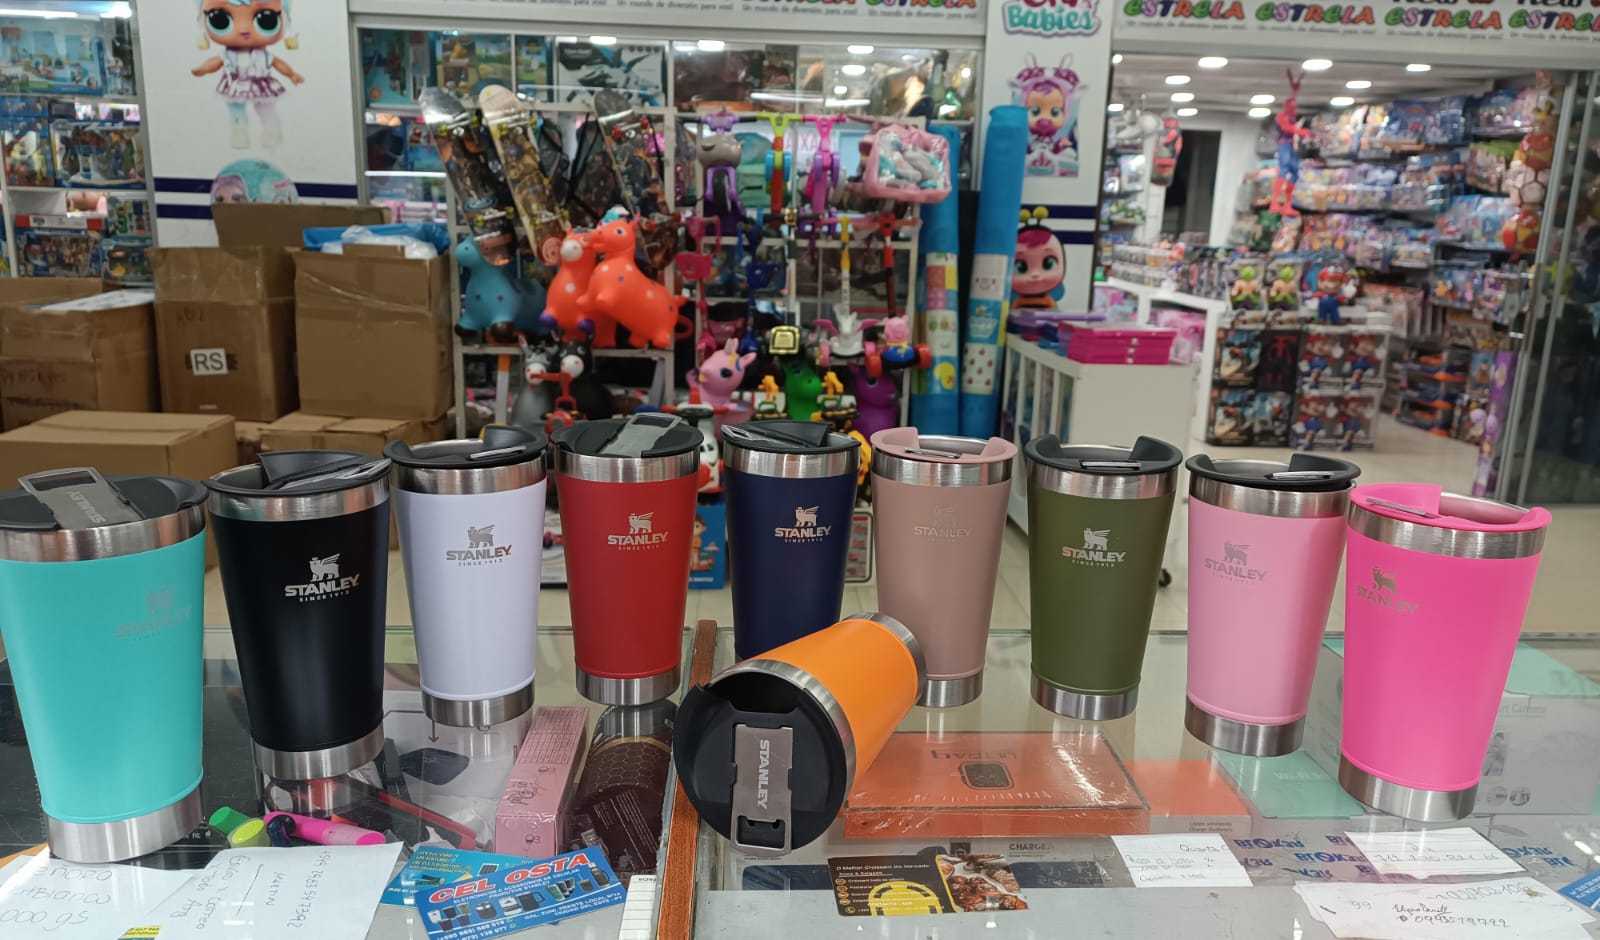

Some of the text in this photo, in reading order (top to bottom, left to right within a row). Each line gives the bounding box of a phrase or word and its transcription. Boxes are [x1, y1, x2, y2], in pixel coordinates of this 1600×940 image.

[1007, 5, 1094, 32] Babies
[1123, 0, 1245, 20] ESTRELA
[1255, 2, 1375, 24] ESTRELA
[1384, 7, 1502, 29] ESTRELA
[193, 351, 224, 372] RS
[607, 531, 669, 546] STANLEY
[774, 525, 832, 539] STANLEY
[912, 526, 974, 538] STANLEY
[446, 544, 513, 561] STANLEY
[1061, 545, 1127, 563] STANLEY
[1204, 557, 1268, 581] STANLEY
[284, 573, 361, 597] STANLEY
[1356, 585, 1420, 615] STANLEY
[757, 739, 770, 811] STANLEY
[428, 878, 497, 903] CEL
[504, 853, 591, 884] OSTA
